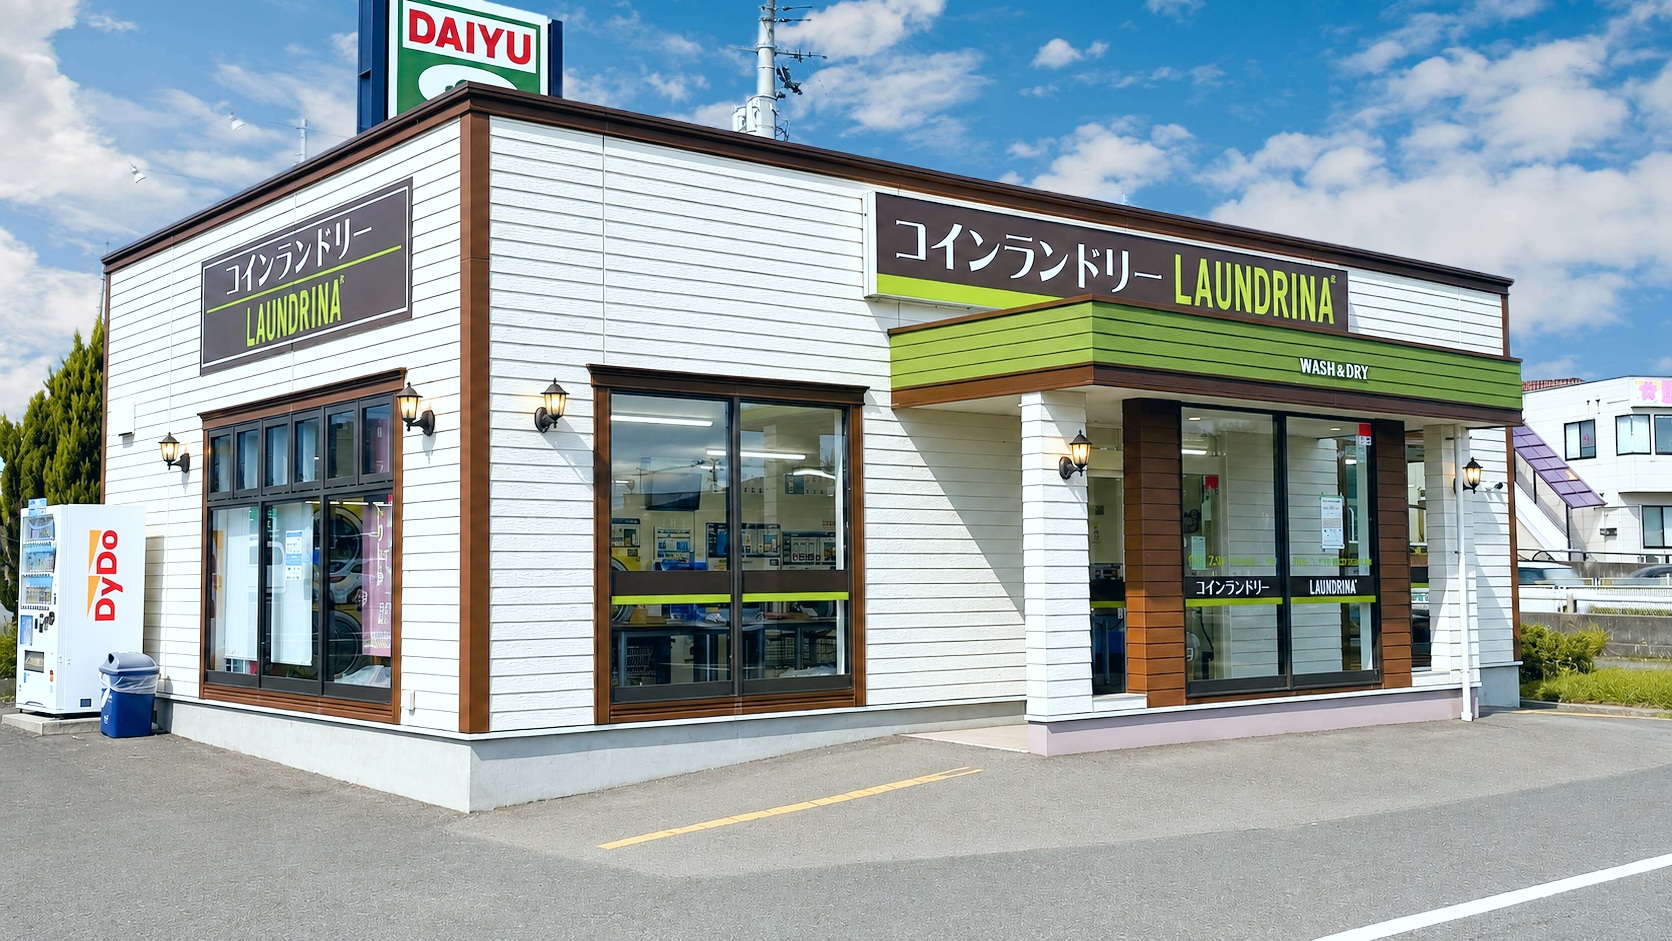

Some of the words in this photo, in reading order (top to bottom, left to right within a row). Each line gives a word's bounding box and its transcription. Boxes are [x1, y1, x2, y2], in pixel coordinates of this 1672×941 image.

[408, 8, 531, 65] DAIYU
[225, 218, 373, 295] コインランドリー
[896, 219, 1163, 293] コインランドリー
[94, 529, 124, 621] DyDo
[1196, 579, 1270, 596] コインランドリー
